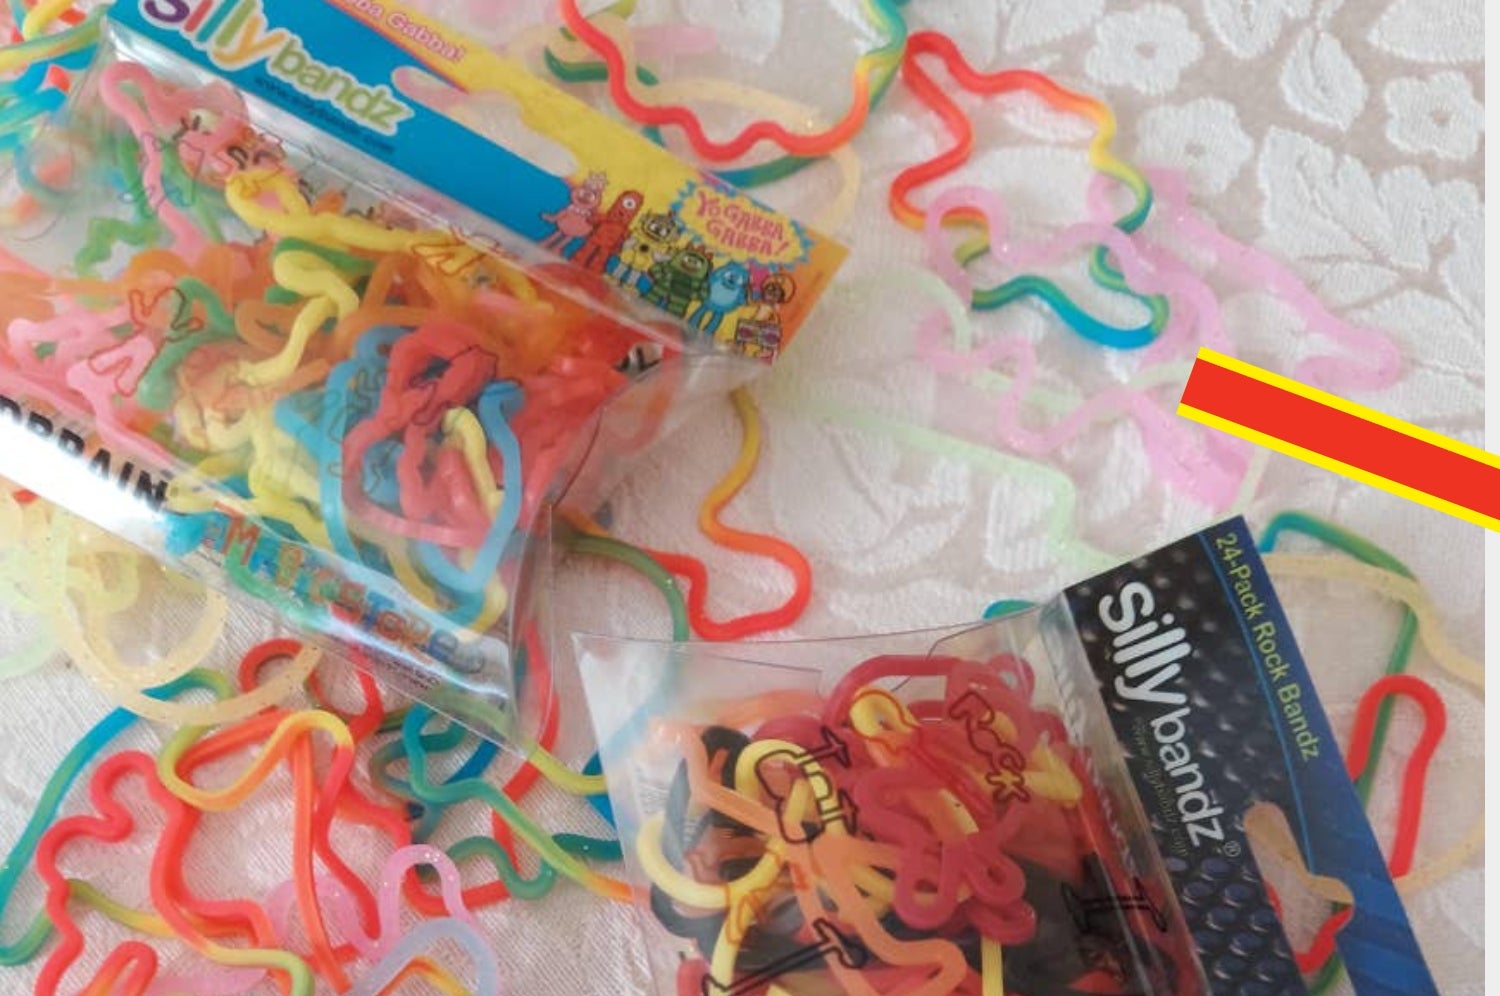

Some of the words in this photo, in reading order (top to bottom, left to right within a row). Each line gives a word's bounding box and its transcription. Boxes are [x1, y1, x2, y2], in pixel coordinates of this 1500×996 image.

[270, 38, 405, 128] bandz
[1098, 582, 1192, 704] Silly
[1216, 532, 1265, 626] 24-Pack
[1251, 624, 1290, 684] Rock
[1277, 684, 1319, 761] Bandz
